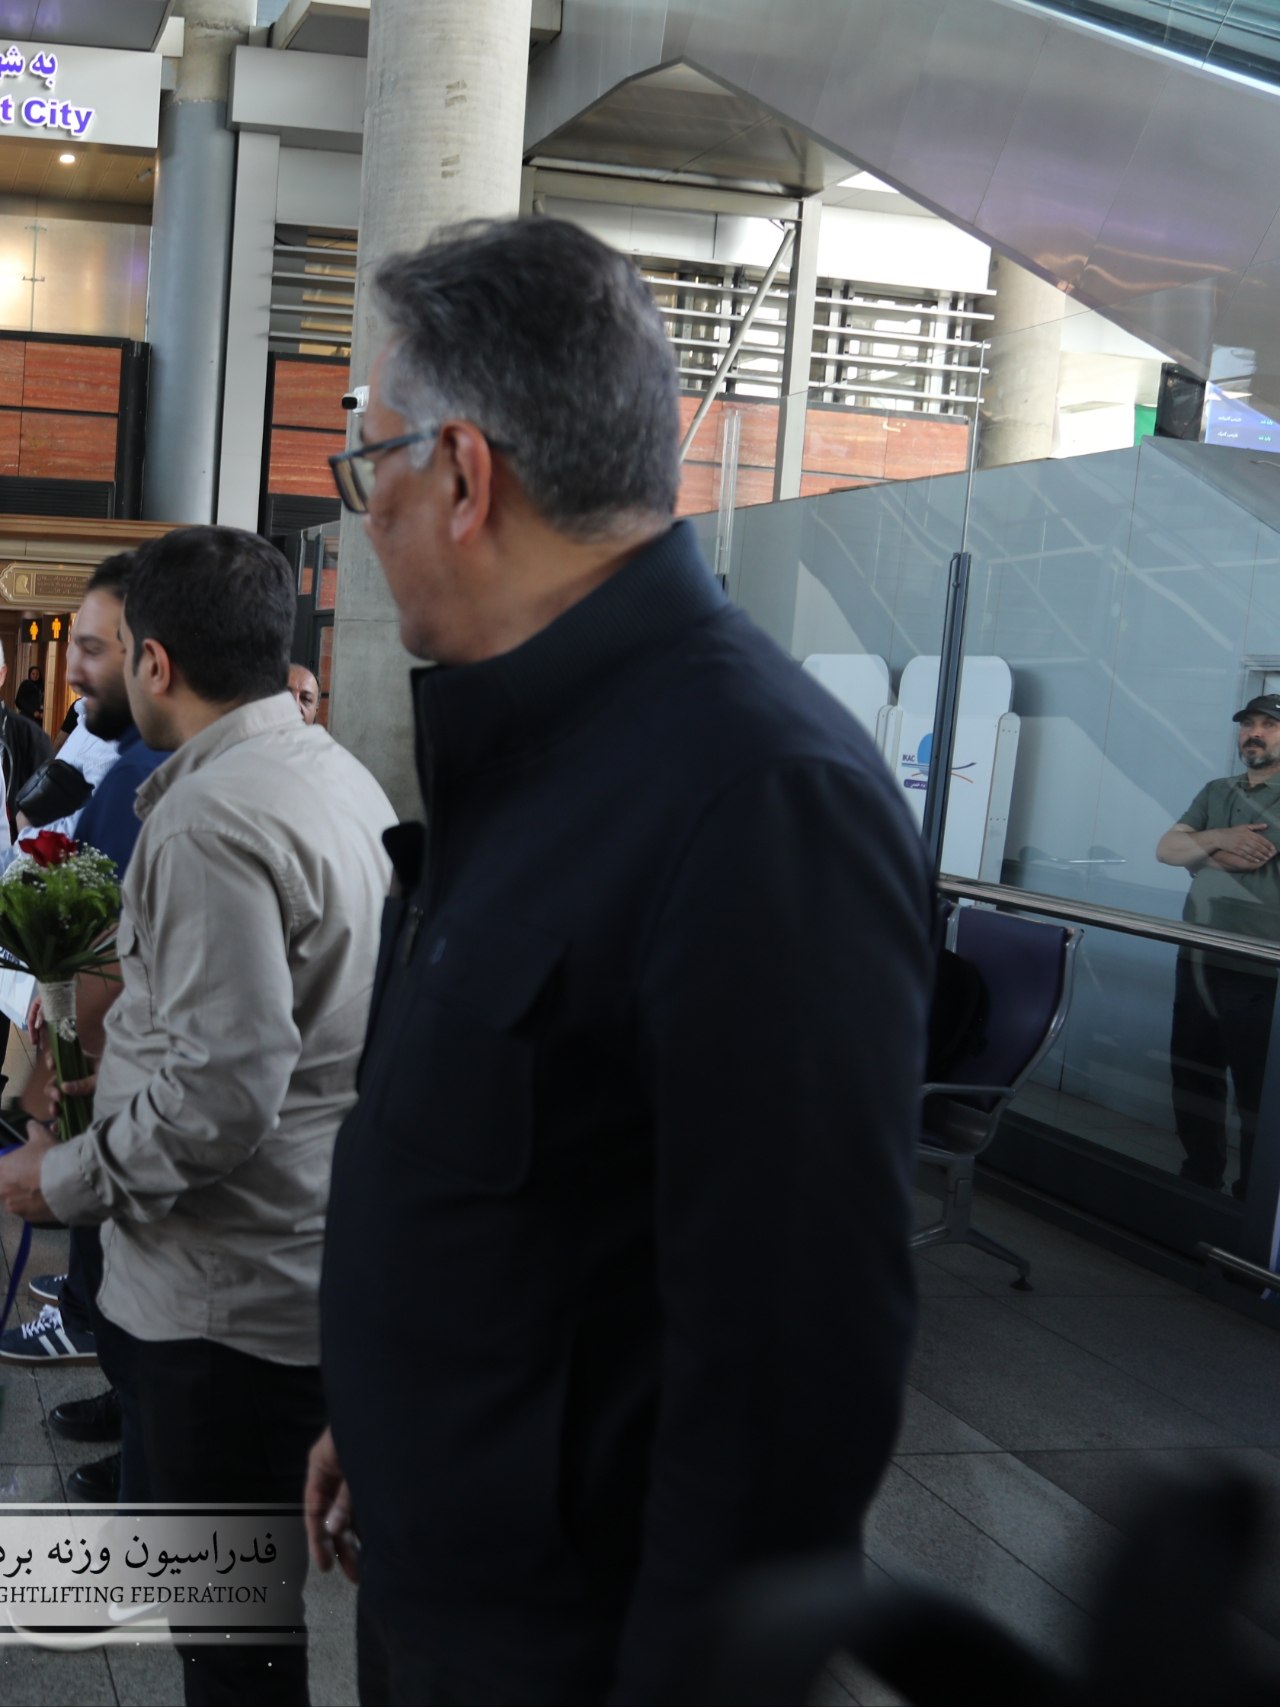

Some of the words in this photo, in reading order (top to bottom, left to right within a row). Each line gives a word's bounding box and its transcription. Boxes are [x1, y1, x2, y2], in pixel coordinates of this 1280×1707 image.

[31, 51, 58, 88] به
[22, 98, 96, 136] City
[902, 754, 916, 762] IKAC
